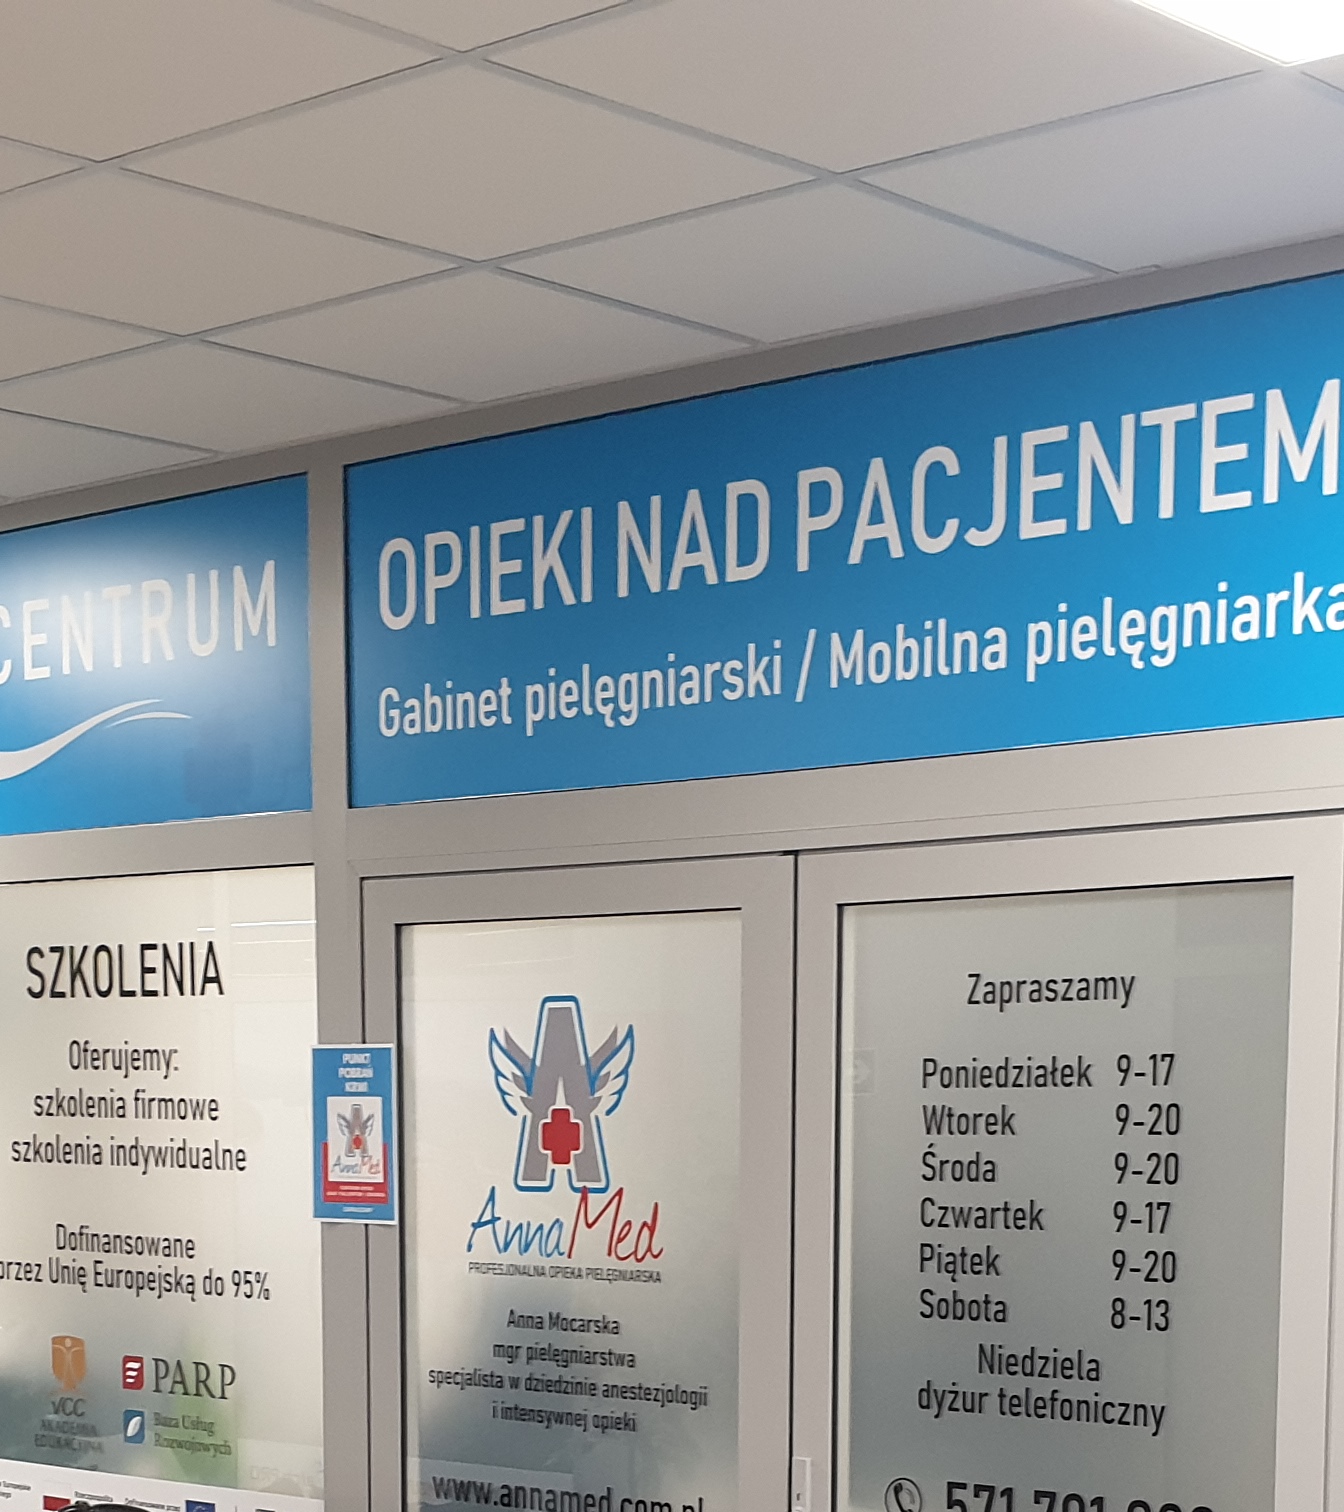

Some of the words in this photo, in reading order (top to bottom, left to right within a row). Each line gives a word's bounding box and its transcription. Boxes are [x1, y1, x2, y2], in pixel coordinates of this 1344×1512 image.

[378, 505, 593, 630] OPIEKI
[617, 478, 771, 598] NAD
[796, 378, 1341, 572] PACJENTEM
[378, 677, 512, 737] Gabinet
[525, 639, 782, 736] pielęgniarski
[830, 618, 1007, 688] Mobilna
[25, 940, 225, 999] SZKOLENIA
[966, 973, 1136, 1013] Zapraszamy
[68, 1039, 179, 1079] Oferujemy:
[921, 1055, 1093, 1088] Poniedziałek
[1116, 1053, 1175, 1087] 9-17
[33, 1088, 127, 1119] szkolenia
[133, 1088, 220, 1121] firmowe
[922, 1104, 1017, 1136] Wtorek
[1115, 1103, 1180, 1136] 9-20
[11, 1134, 103, 1166] szkolenia
[109, 1136, 248, 1175] indywidualne
[921, 1143, 996, 1182] Środa
[1114, 1152, 1179, 1185] 9-20
[920, 1197, 1045, 1231] Czwartek
[1113, 1201, 1171, 1234] 9-17
[55, 1223, 196, 1259] Dofinansowane
[48, 1257, 87, 1293] Unię
[93, 1261, 196, 1302] Europejską
[203, 1268, 224, 1297] do
[231, 1270, 271, 1300] 95%
[919, 1243, 1000, 1282] Piątek
[1111, 1249, 1176, 1283] 9-20
[507, 1309, 543, 1330] Anna
[548, 1312, 620, 1335] Mocarska
[919, 1288, 1008, 1323] Sobota
[1110, 1297, 1170, 1331] 8-13
[492, 1343, 519, 1364] mgr
[526, 1342, 636, 1368] pielęgniarstwa
[978, 1343, 1101, 1381] Niedziela
[151, 1357, 236, 1400] PARP
[428, 1368, 504, 1390] specjalista
[508, 1376, 520, 1390] w
[524, 1372, 597, 1397] dziedzinie
[601, 1383, 709, 1411] anestezjologii
[51, 1397, 86, 1417] VCC
[500, 1401, 588, 1432] intensywnej
[592, 1412, 638, 1434] opieki
[917, 1379, 988, 1419] dyżur
[998, 1387, 1166, 1437] telefoniczny
